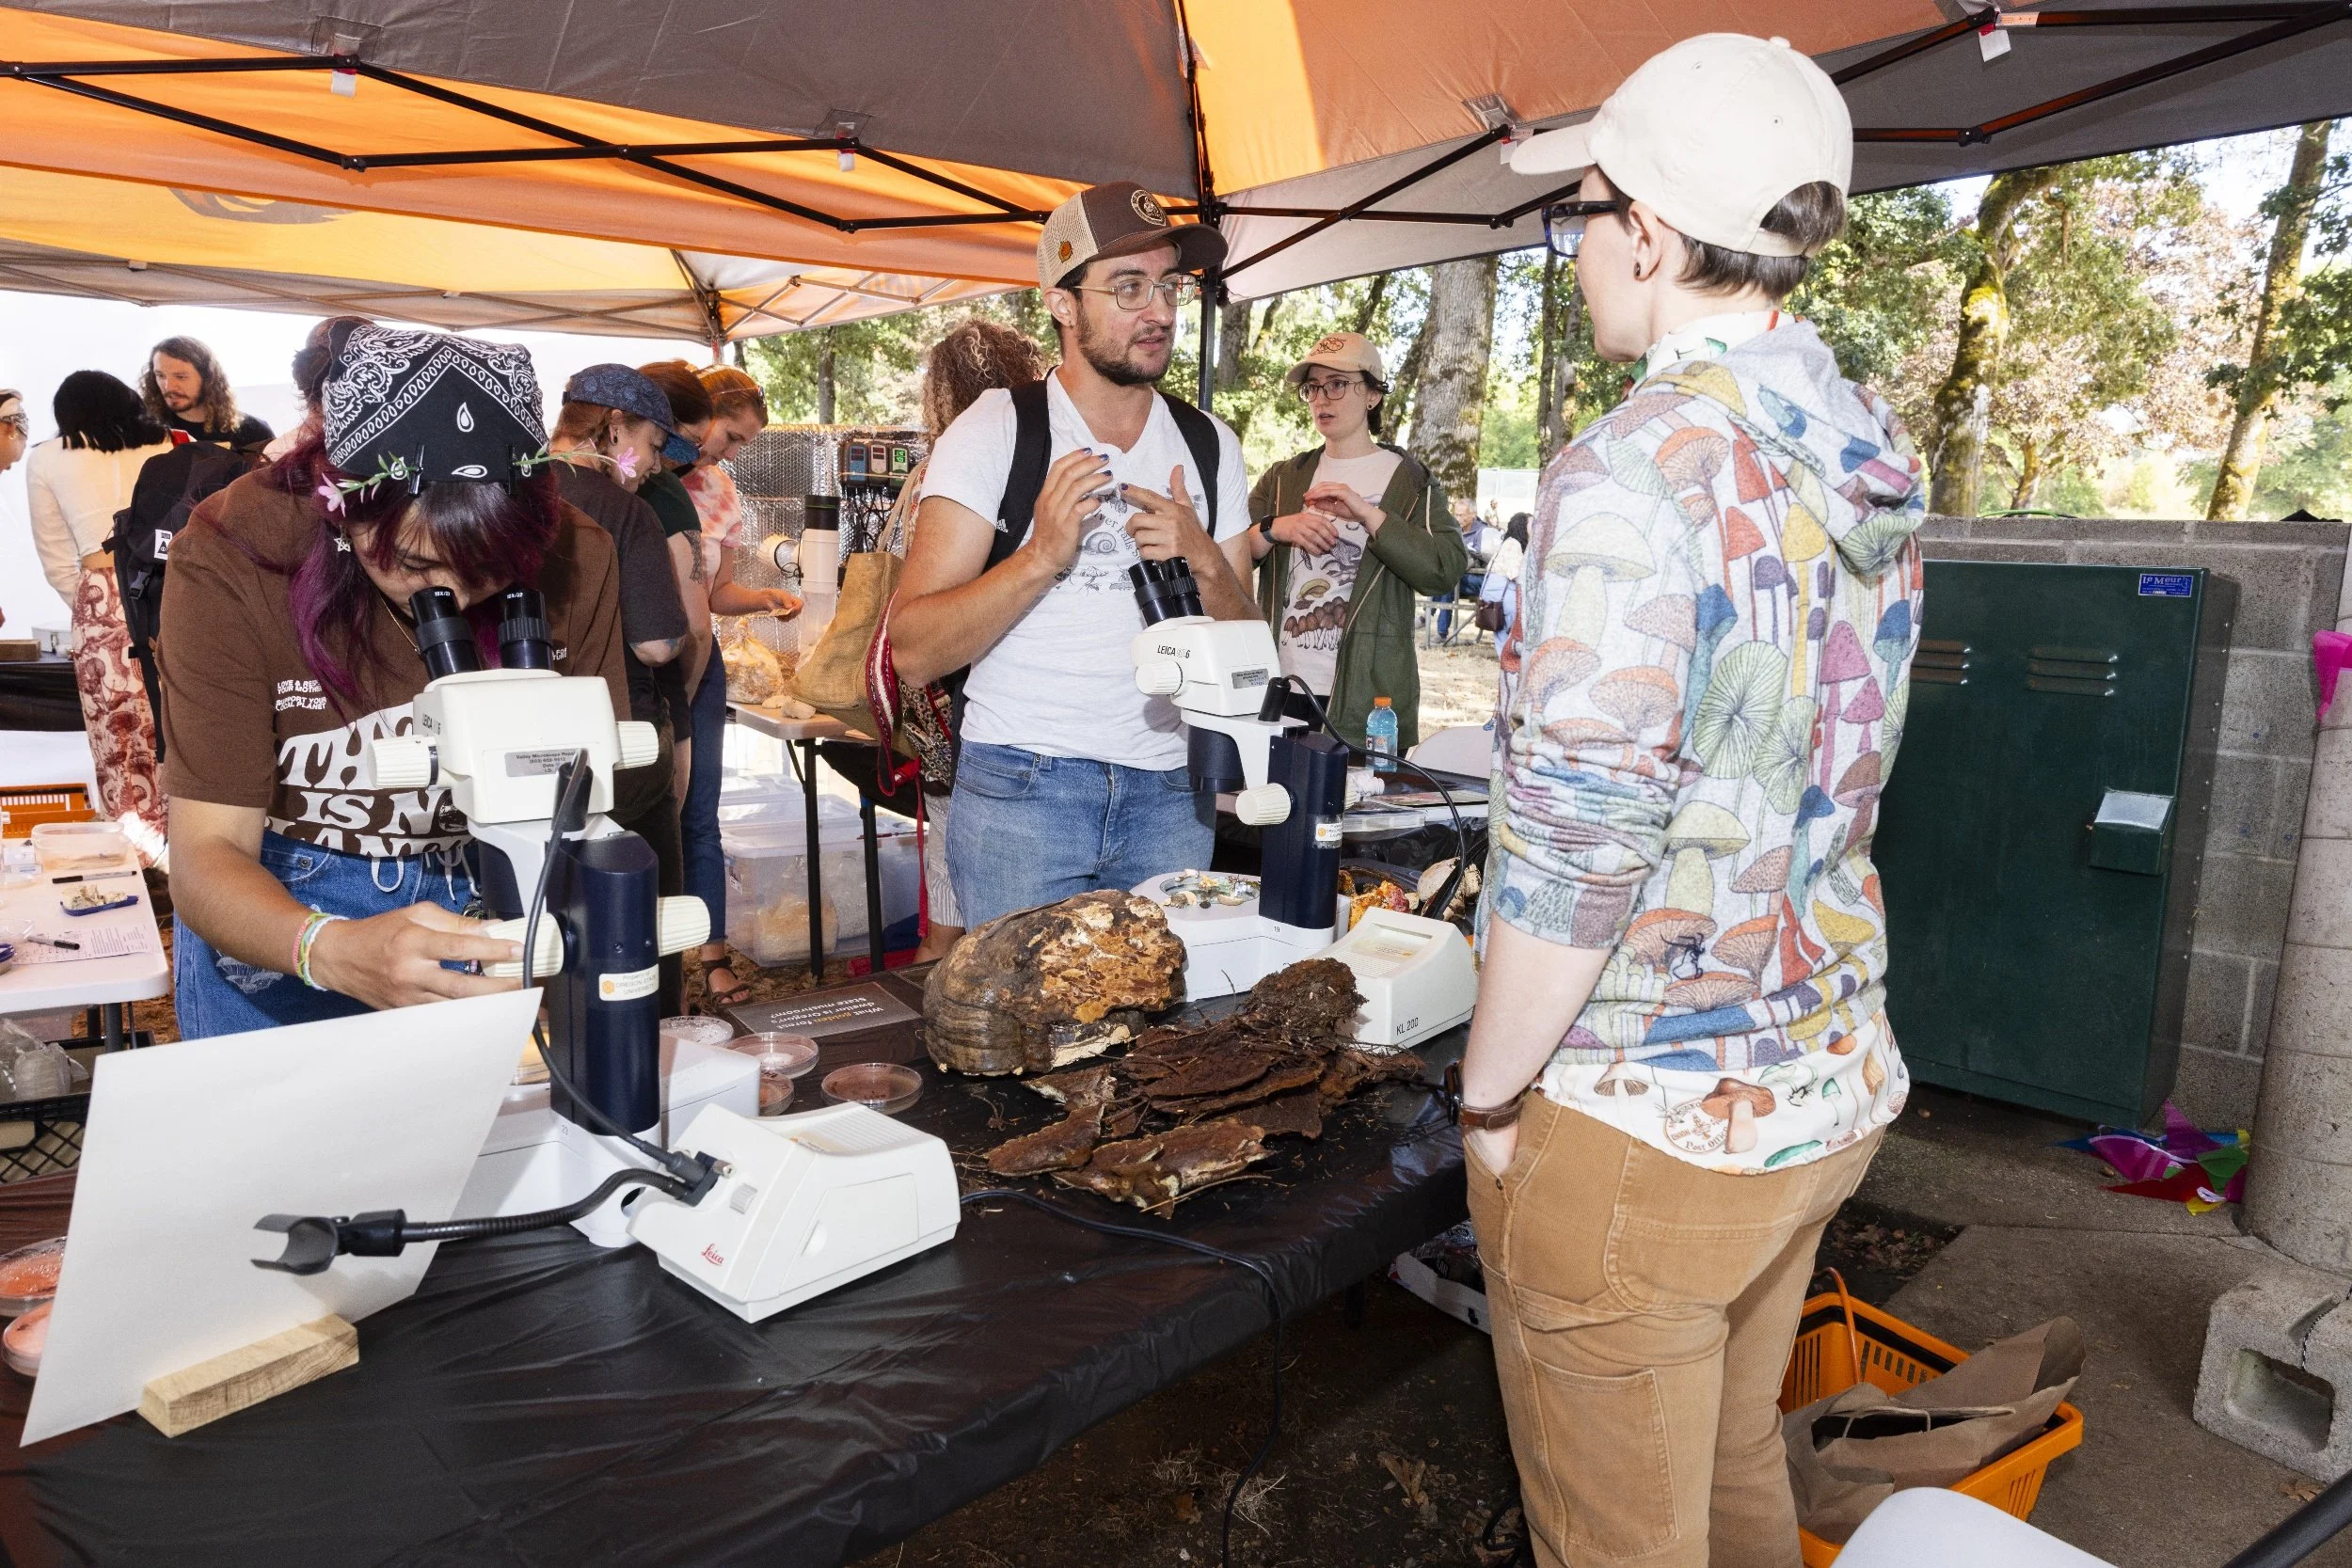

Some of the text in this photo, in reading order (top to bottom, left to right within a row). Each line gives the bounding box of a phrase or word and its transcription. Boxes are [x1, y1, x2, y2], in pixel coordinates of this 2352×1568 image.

[1157, 644, 1176, 657] LEICA
[277, 679, 294, 689] LOVE
[275, 695, 308, 706] SUPPORT
[296, 791, 375, 830] IS
[1396, 1017, 1419, 1037] KL 200
[700, 1242, 725, 1265] Leica
